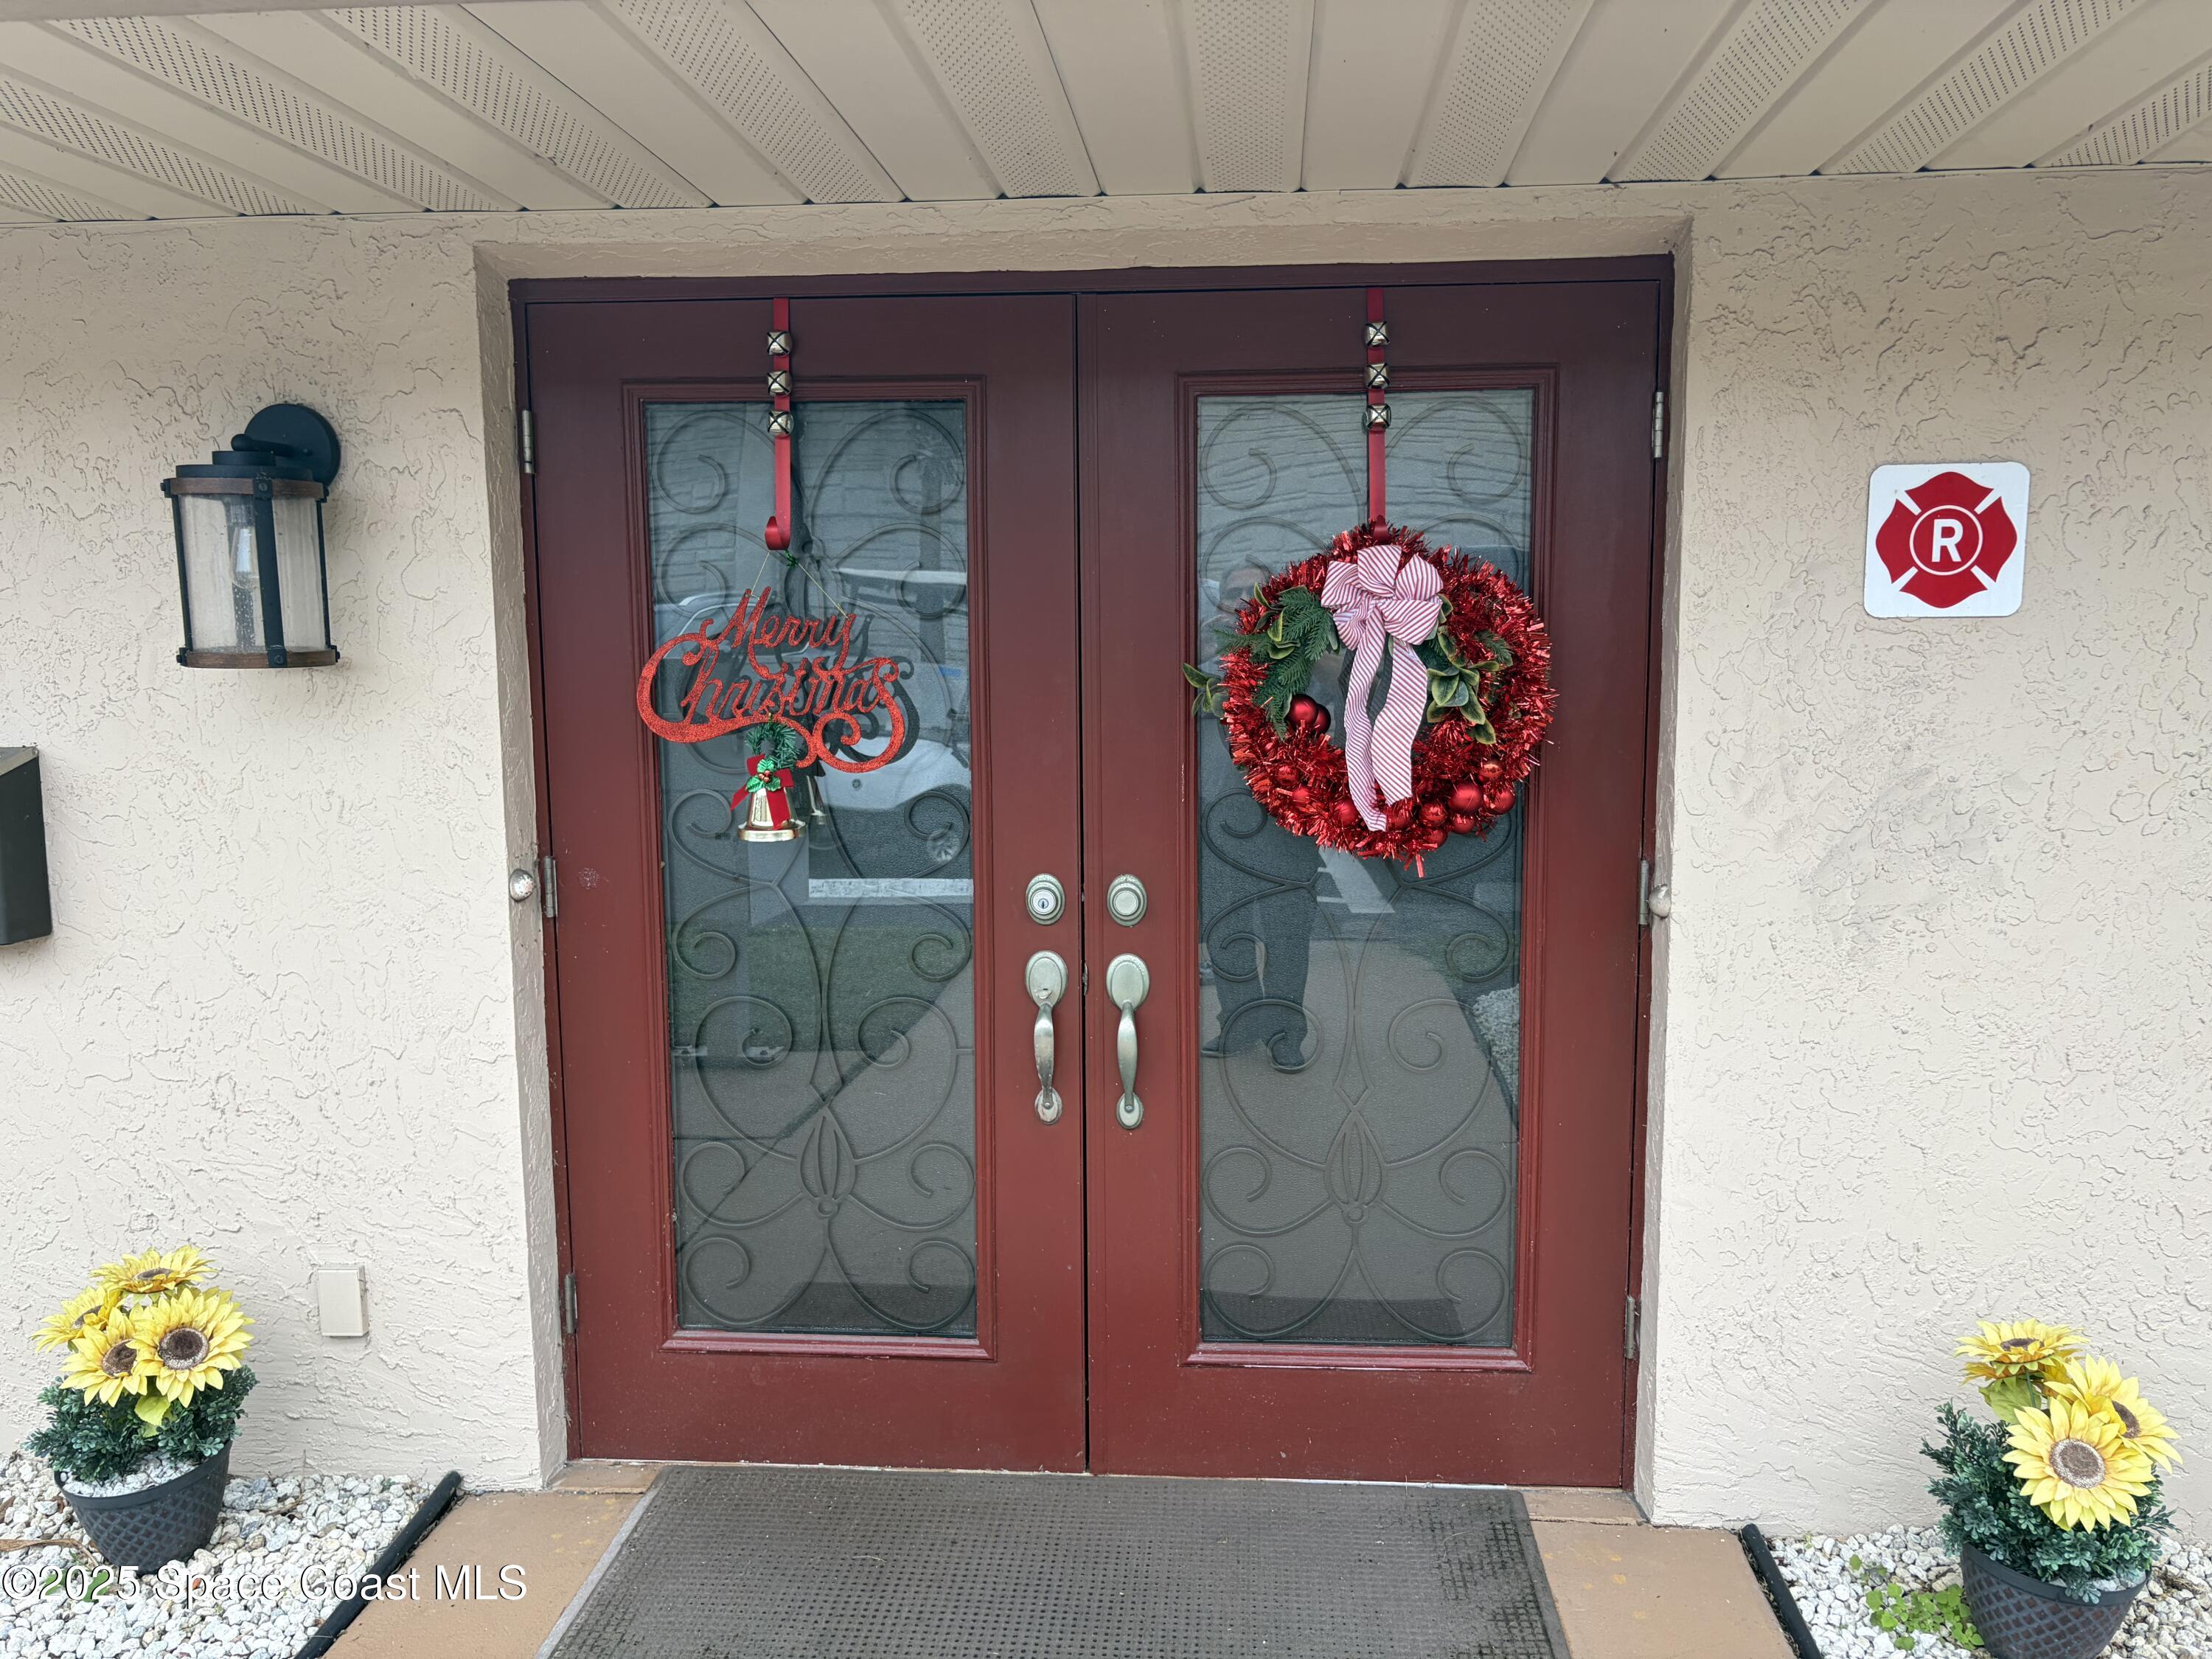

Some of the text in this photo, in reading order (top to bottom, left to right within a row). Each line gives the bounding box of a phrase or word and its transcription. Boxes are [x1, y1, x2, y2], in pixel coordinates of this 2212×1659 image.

[1931, 518, 1964, 563] R
[702, 586, 856, 680] Merry
[636, 633, 905, 773] Christmas
